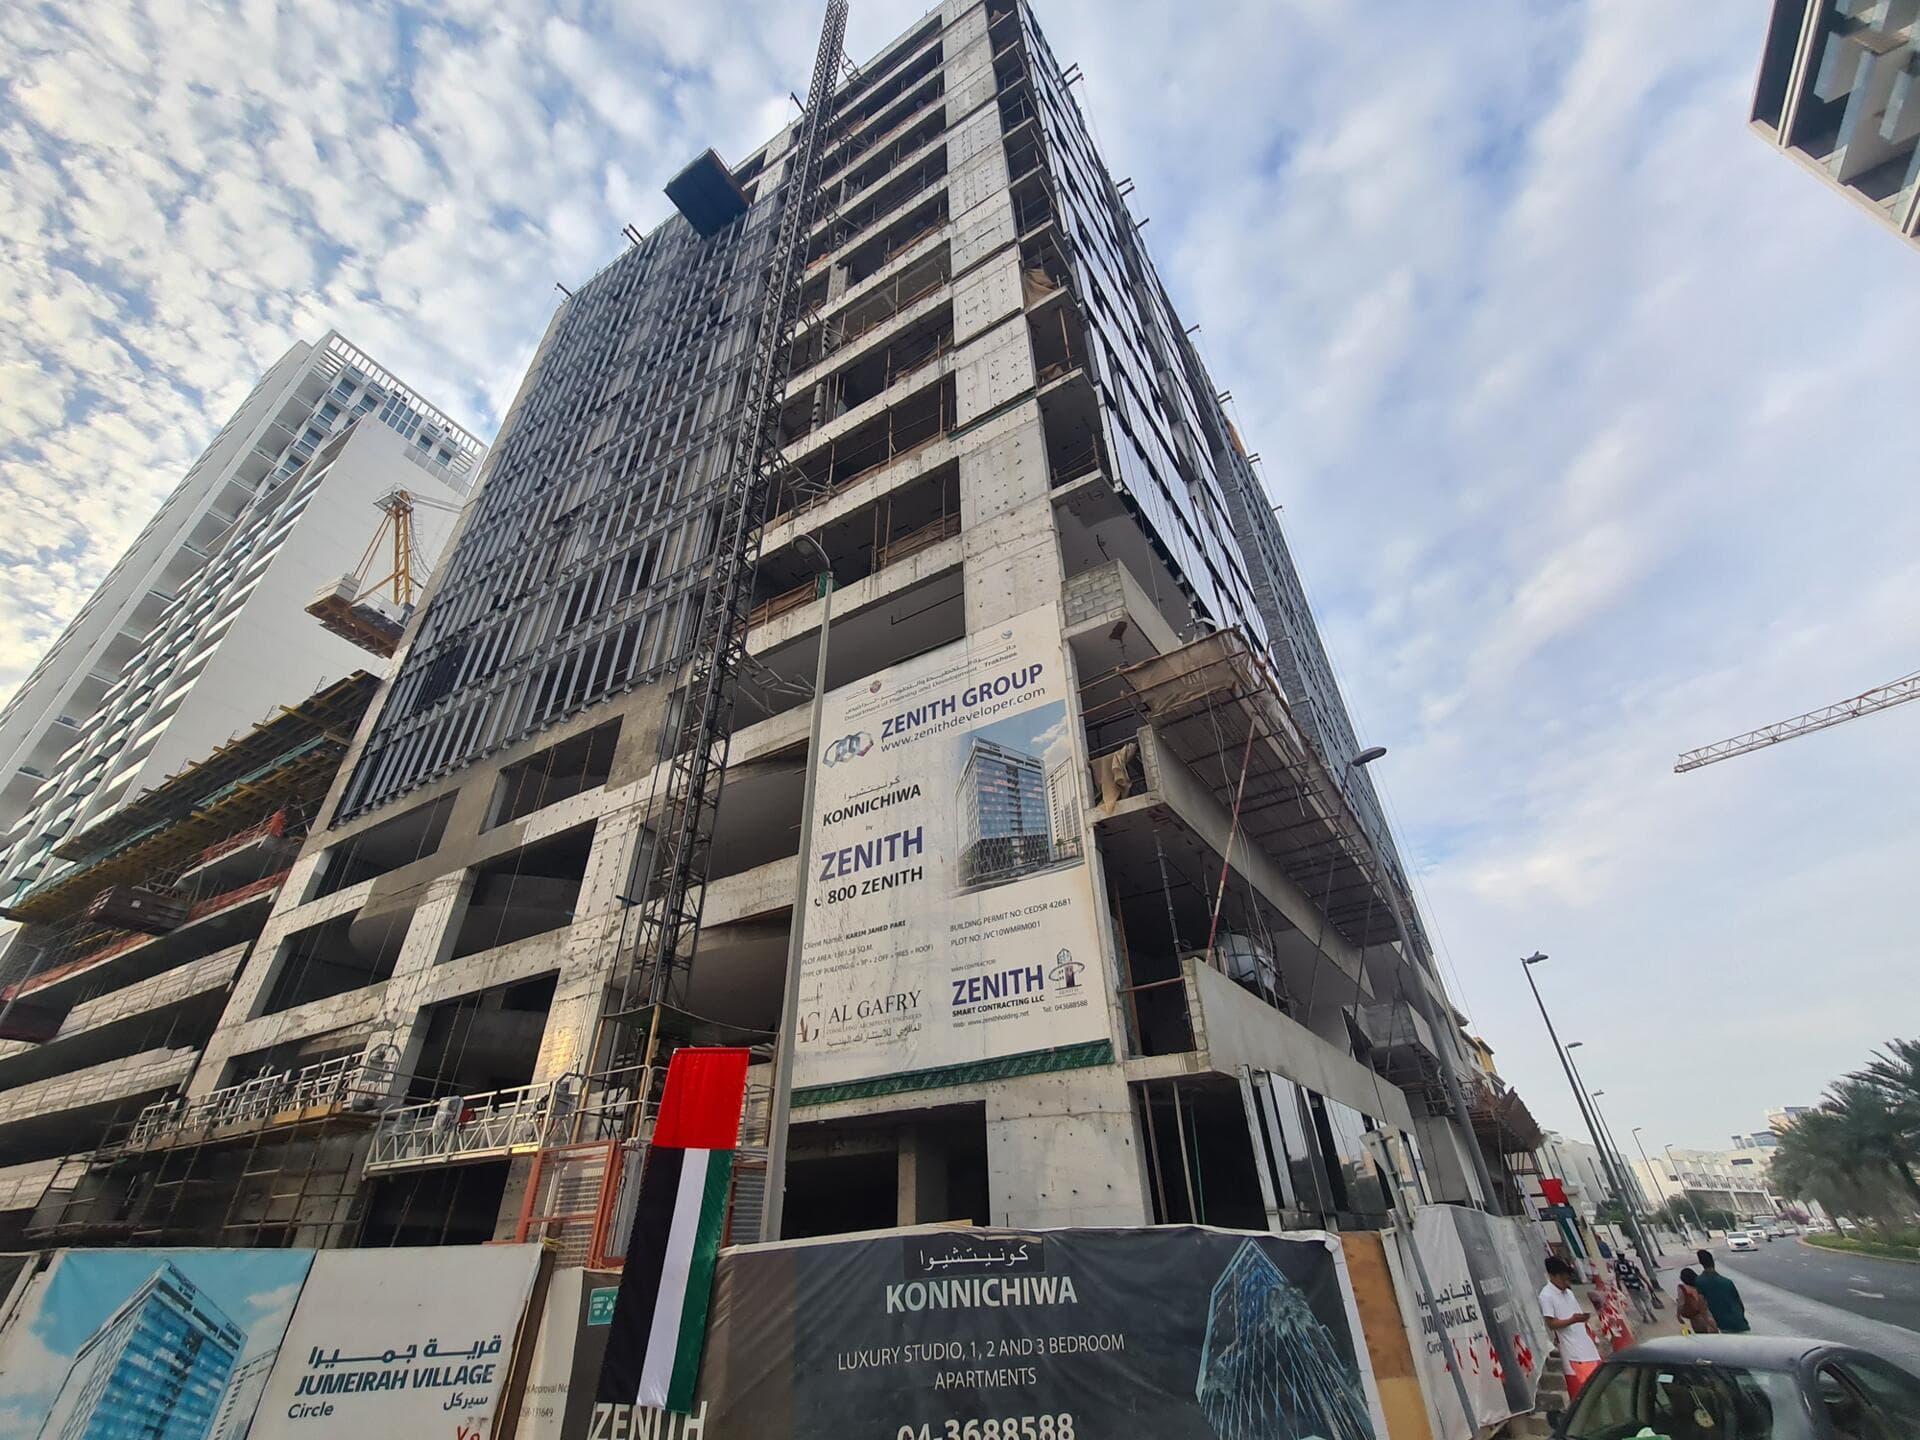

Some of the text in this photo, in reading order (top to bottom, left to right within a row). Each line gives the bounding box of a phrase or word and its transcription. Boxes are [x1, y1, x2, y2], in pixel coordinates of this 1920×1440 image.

[882, 663, 1044, 739] ZENITH GROUP
[880, 686, 1047, 753] www.zenithdeveloper.com
[823, 784, 922, 827] KONNICHIWA
[819, 826, 923, 882] ZENITH
[827, 865, 923, 905] 800 ZENITH
[950, 918, 982, 933] BUILDING
[983, 912, 1008, 925] PERMIT
[1024, 902, 1048, 915] CEDSR
[1049, 898, 1072, 909] 42681
[950, 936, 968, 946] PLOT
[952, 964, 1044, 1006] ZENITH
[828, 990, 922, 1024] AL GAFRY
[952, 1006, 976, 1018] SMART
[978, 998, 1030, 1013] CONTRACTING
[1031, 994, 1045, 1002] LLC
[920, 1244, 1029, 1272] كونيتشيوا
[885, 1276, 1078, 1314] KONNICHIWA
[308, 1334, 503, 1369] قرية جميرا
[838, 1334, 1126, 1372] LUXURY STUDIO, 1, 2 AND 3 BEDROOM
[294, 1363, 497, 1396] JUMEIRAH VILLAGE
[934, 1367, 1036, 1390] APARTMENTS
[287, 1401, 335, 1419] Circle
[443, 1392, 489, 1411] سيركل
[896, 1412, 1076, 1440] 04-3688588
